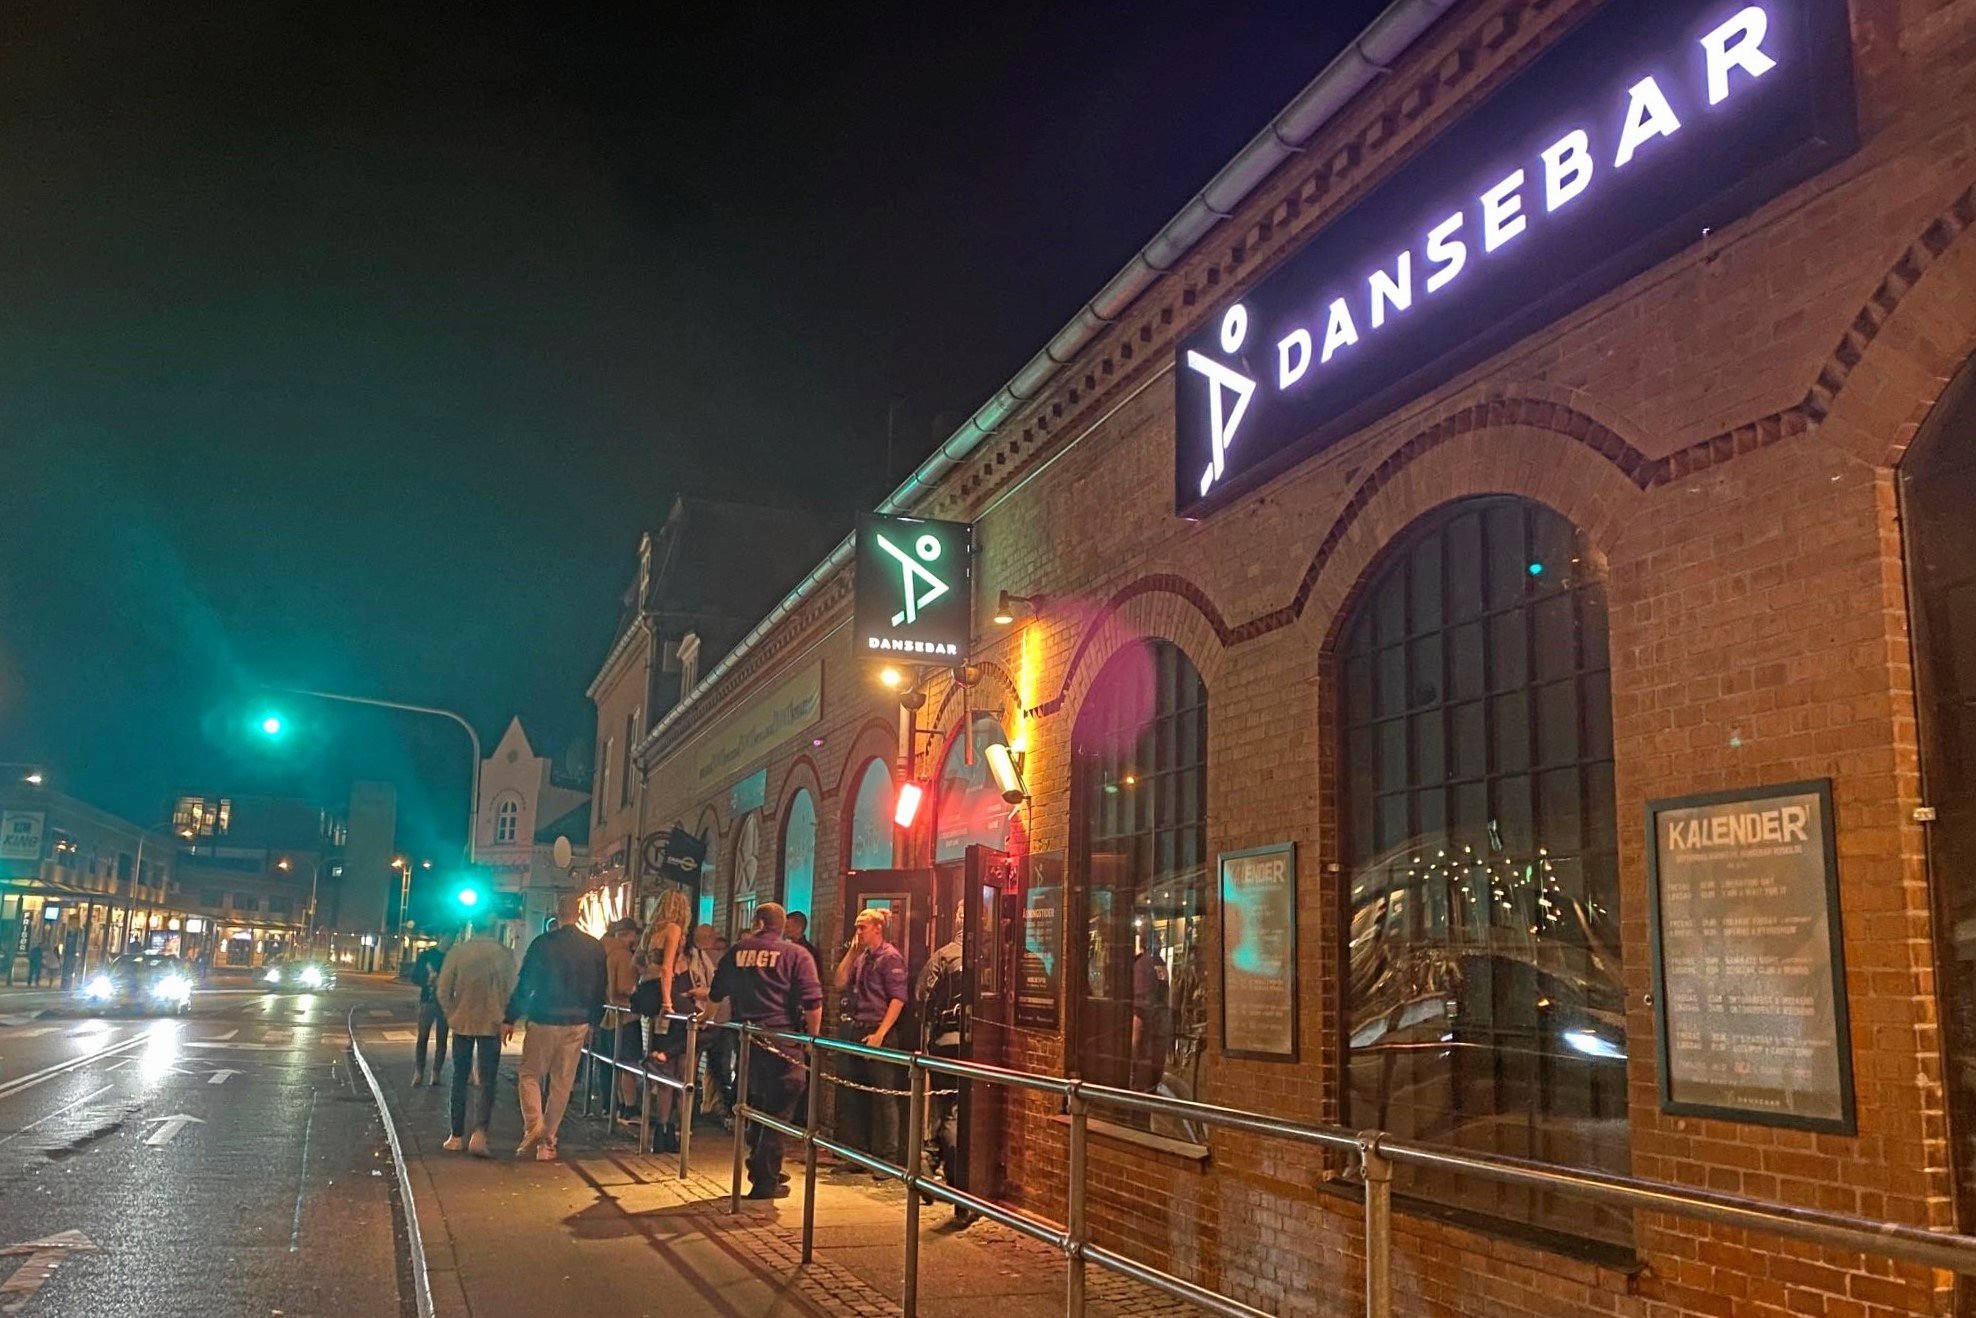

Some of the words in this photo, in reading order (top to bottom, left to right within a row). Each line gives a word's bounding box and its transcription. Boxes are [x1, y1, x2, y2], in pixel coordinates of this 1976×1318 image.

[1277, 5, 1777, 390] DANSEBAR
[868, 637, 958, 655] DANSEBAR
[1668, 805, 1809, 850] KALENDER
